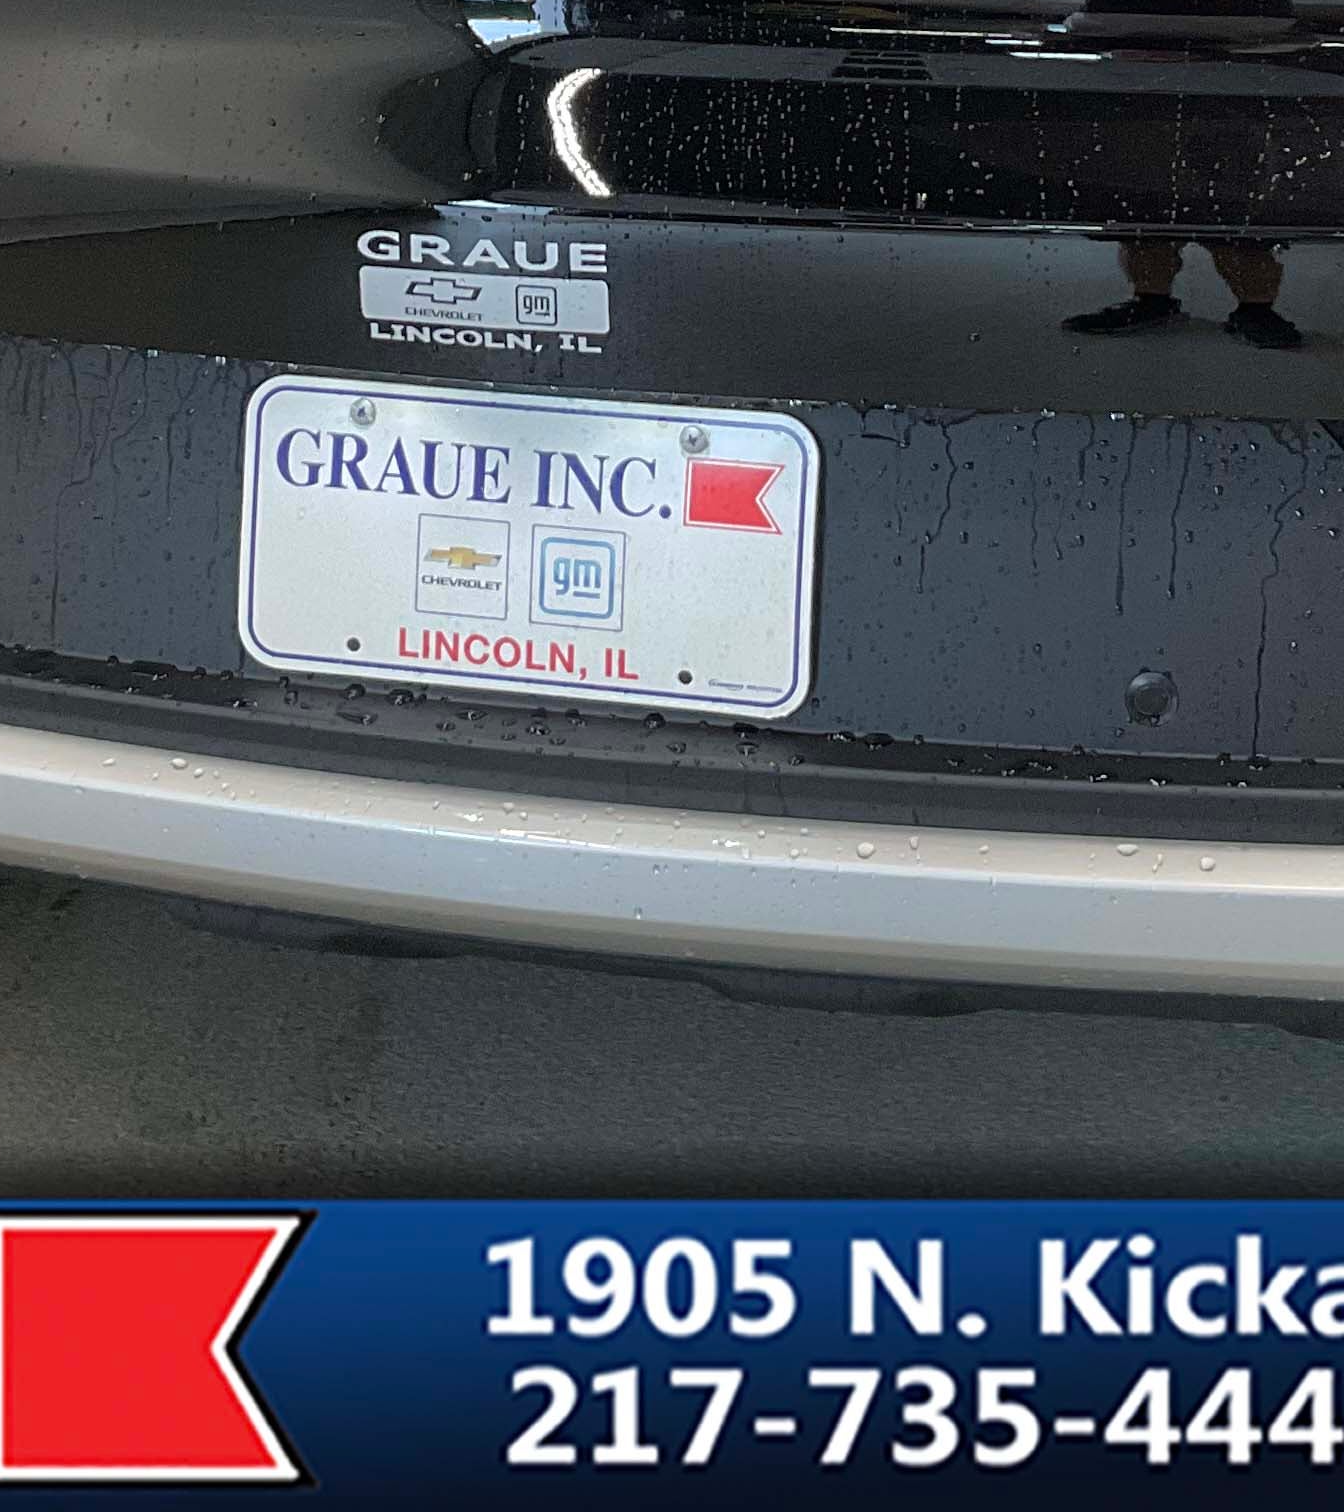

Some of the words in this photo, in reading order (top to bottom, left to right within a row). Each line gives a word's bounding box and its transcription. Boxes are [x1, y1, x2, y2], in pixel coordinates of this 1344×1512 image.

[357, 230, 608, 273] GRAUE
[404, 306, 483, 322] CHEVROLET
[370, 322, 543, 353] LINCOLN,
[559, 334, 603, 354] IL
[276, 428, 510, 505] GRAUE
[530, 448, 672, 520] INC.
[421, 574, 503, 592] CHEVROLET
[553, 556, 603, 599] gm
[398, 627, 588, 681] LINCOLN,
[605, 648, 640, 680] IL
